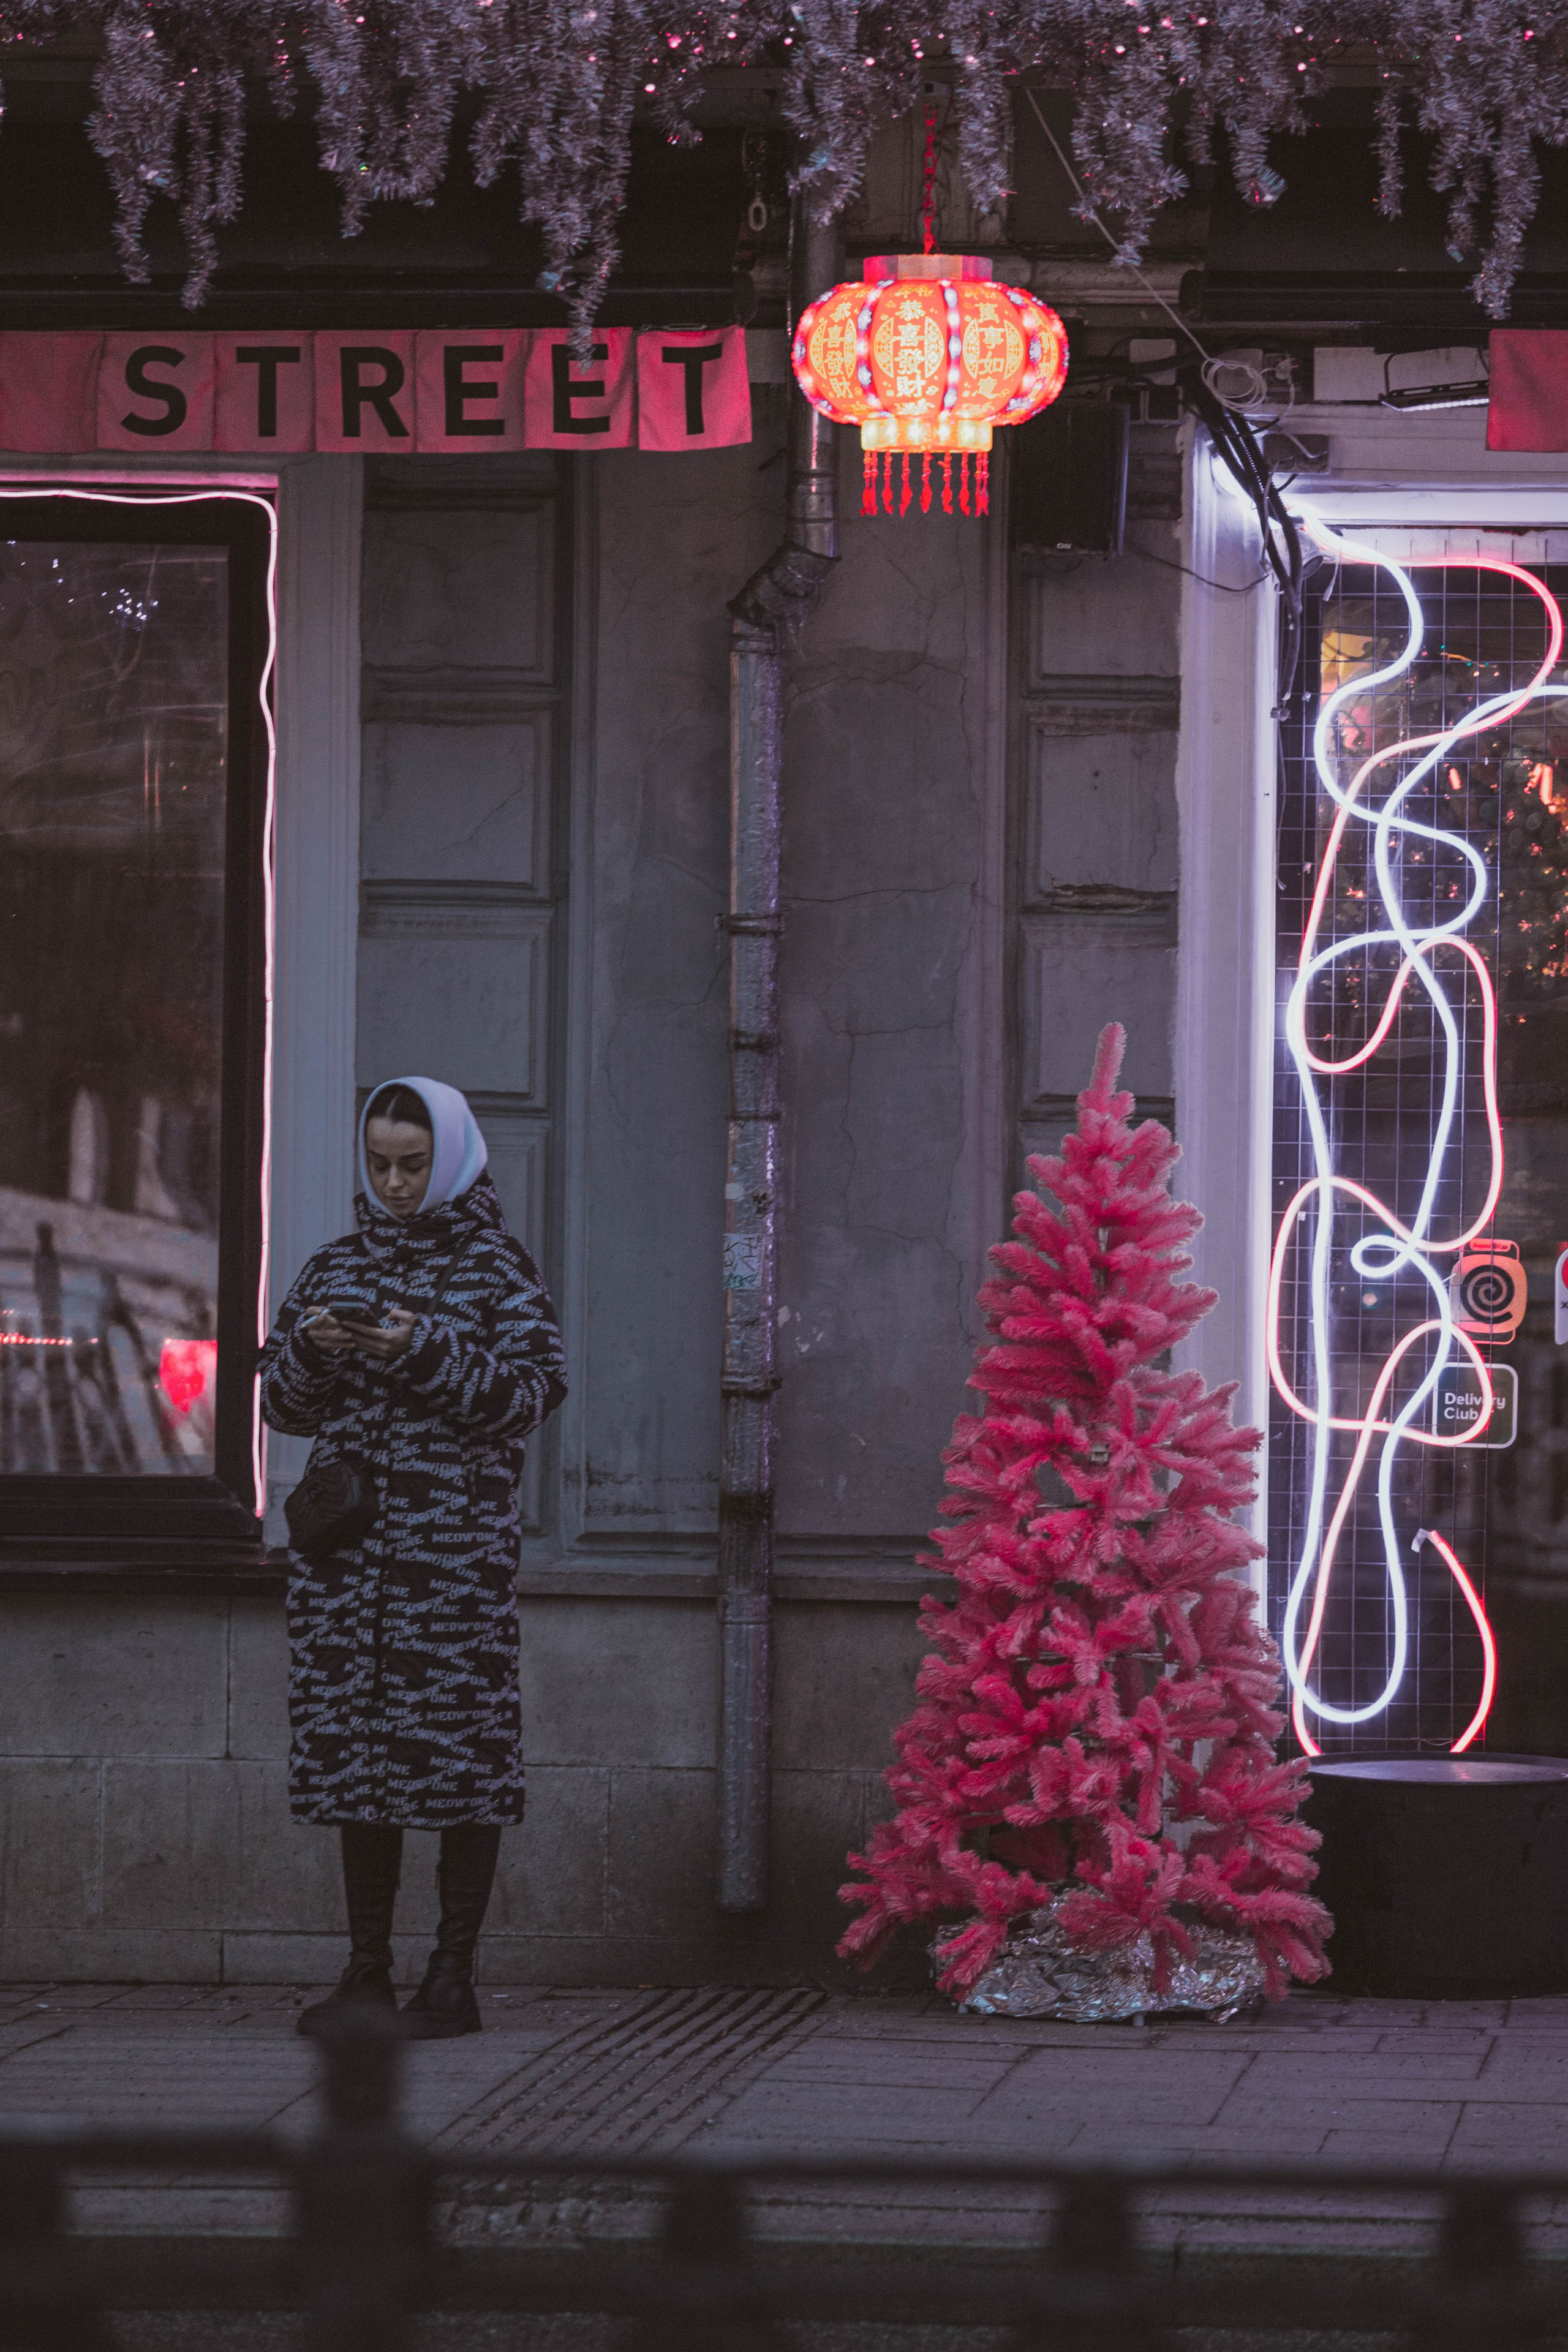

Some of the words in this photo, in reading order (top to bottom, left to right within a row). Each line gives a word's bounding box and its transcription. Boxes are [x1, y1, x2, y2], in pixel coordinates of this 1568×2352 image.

[121, 343, 723, 437] STREET
[892, 300, 926, 398] 恭喜發財
[971, 303, 1005, 399] 萬事如意
[1444, 1392, 1506, 1409] Delivry
[1444, 1407, 1479, 1420] Club
